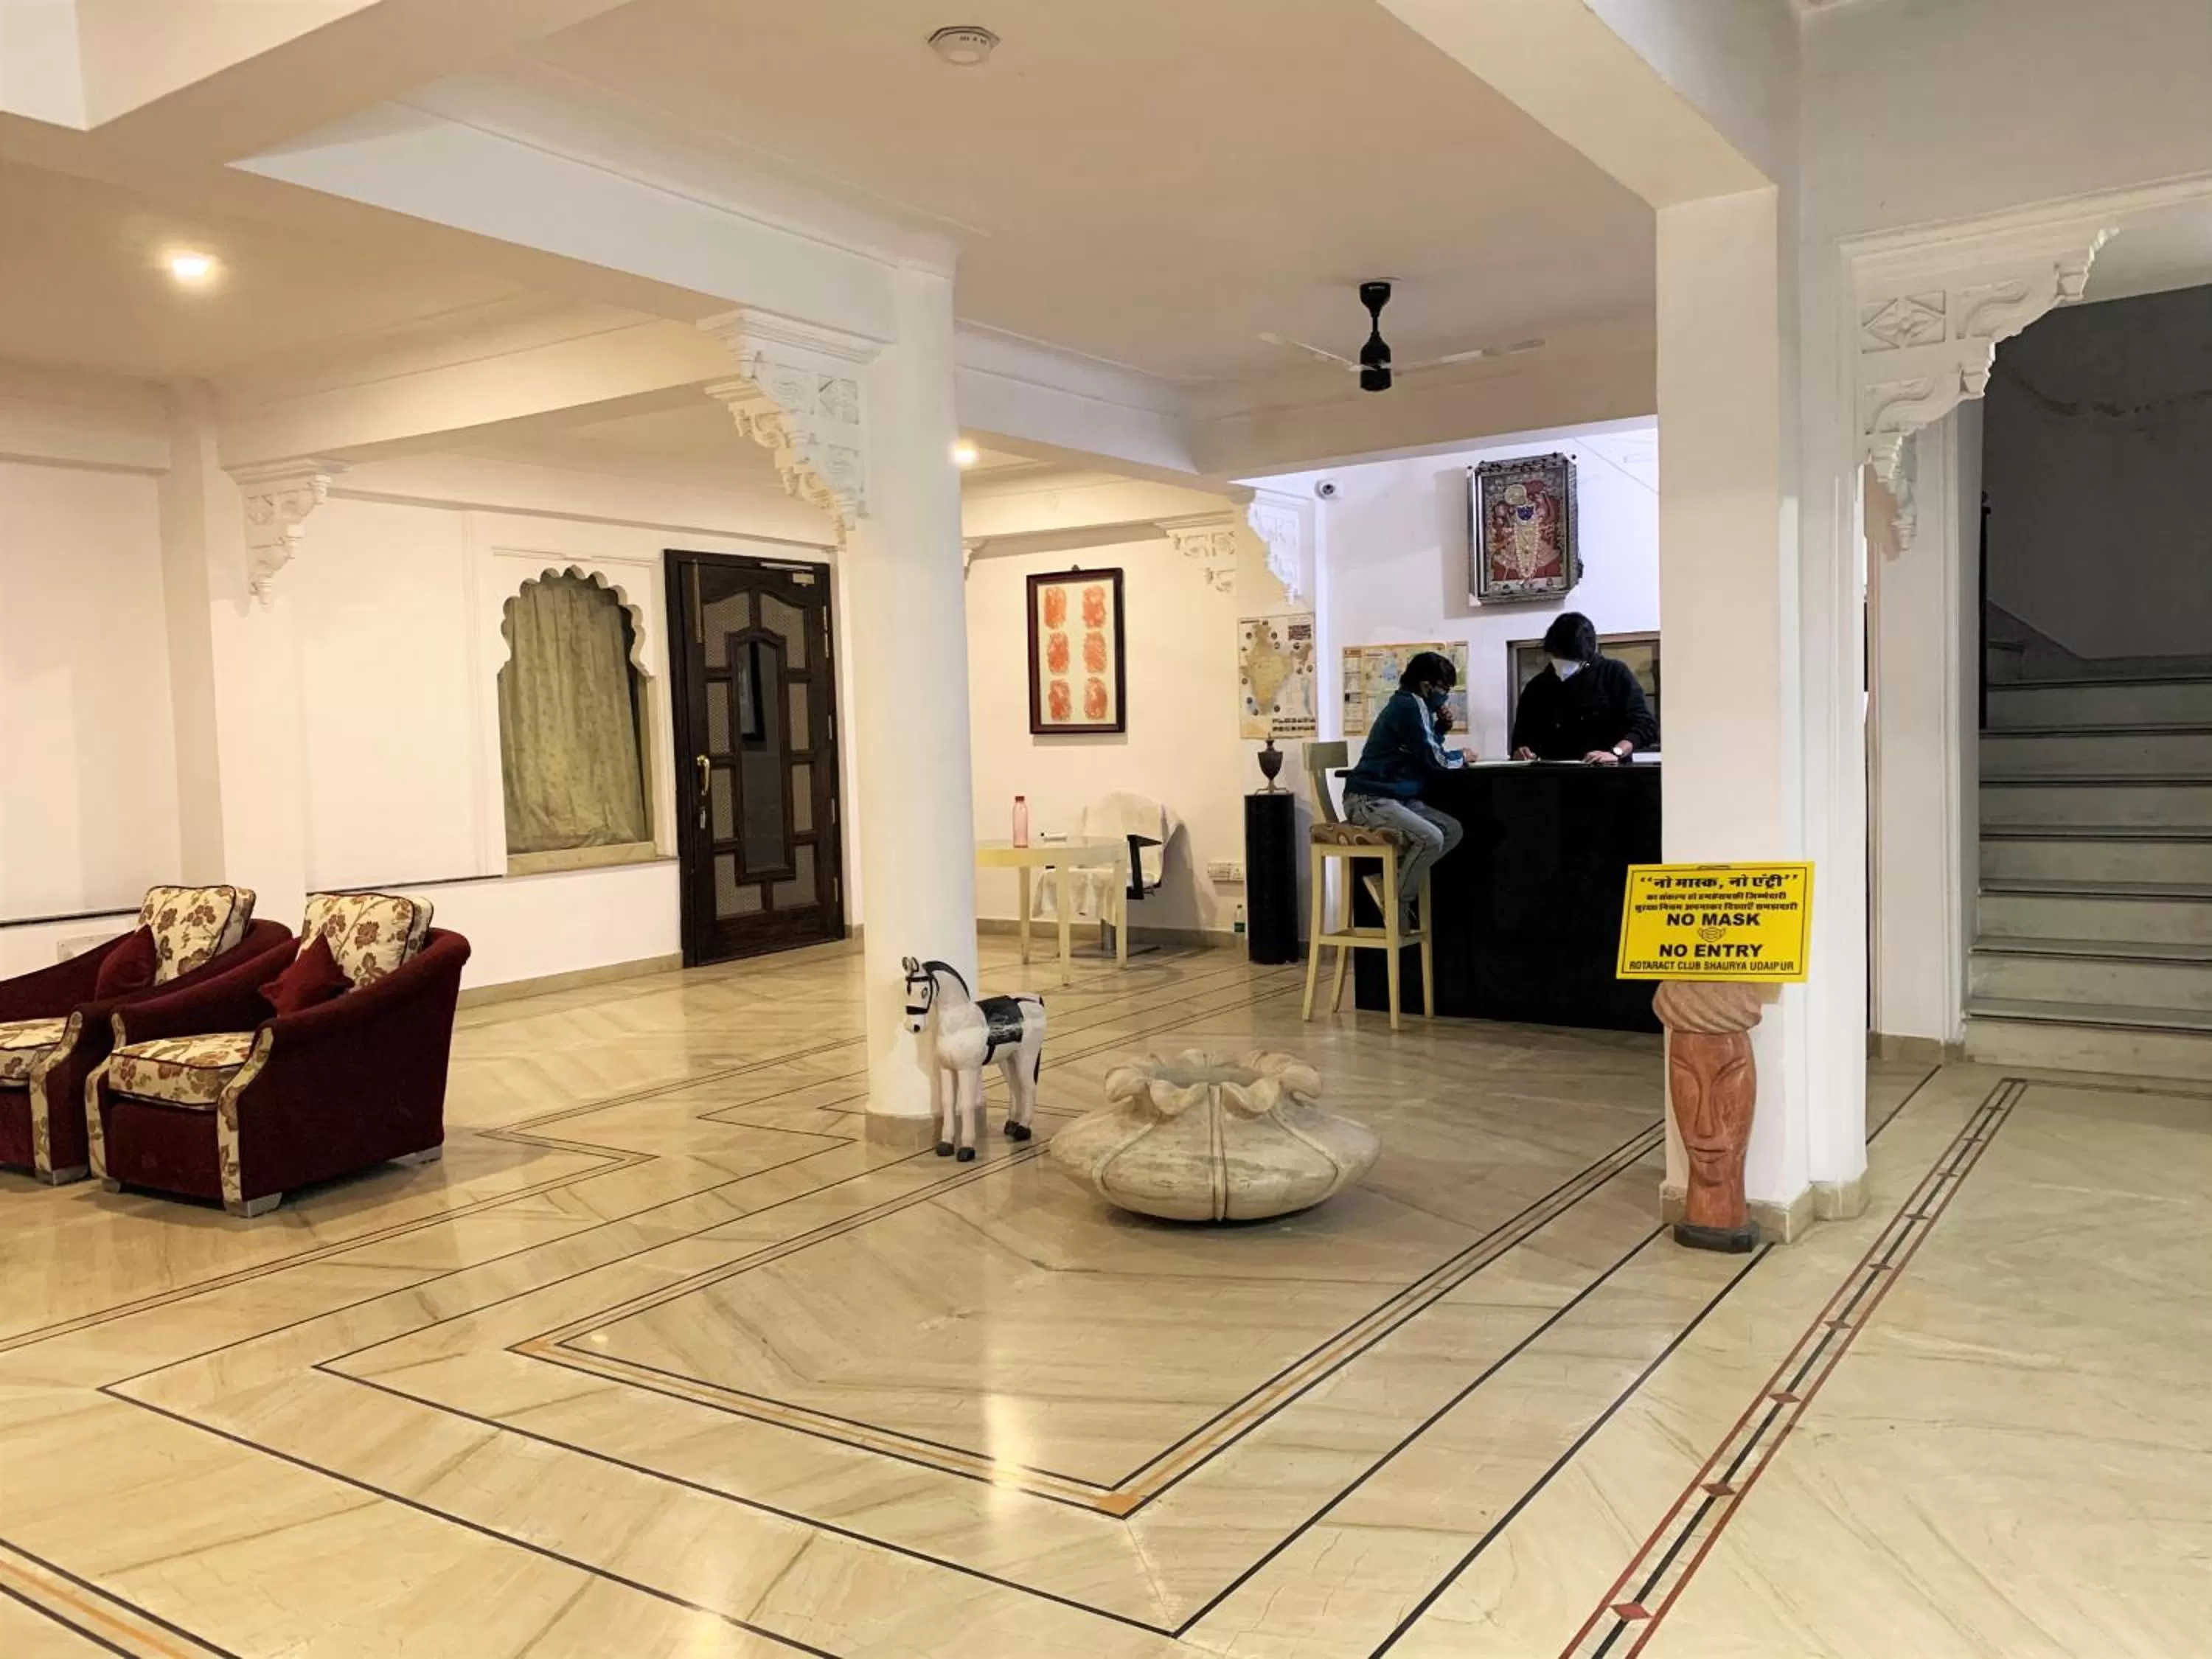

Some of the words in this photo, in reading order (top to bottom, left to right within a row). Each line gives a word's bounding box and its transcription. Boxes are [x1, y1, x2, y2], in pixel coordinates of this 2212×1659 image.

[1728, 874, 1747, 887] नो
[1666, 913, 1695, 926] NO
[1701, 912, 1761, 926] MASK
[1659, 944, 1688, 958] NO
[1694, 944, 1763, 958] ENTRY
[1629, 961, 1675, 970] ROTARACT
[1677, 961, 1701, 971] CLUB
[1703, 961, 1747, 971] SHAURYA
[1750, 961, 1794, 972] UDAIPUR
